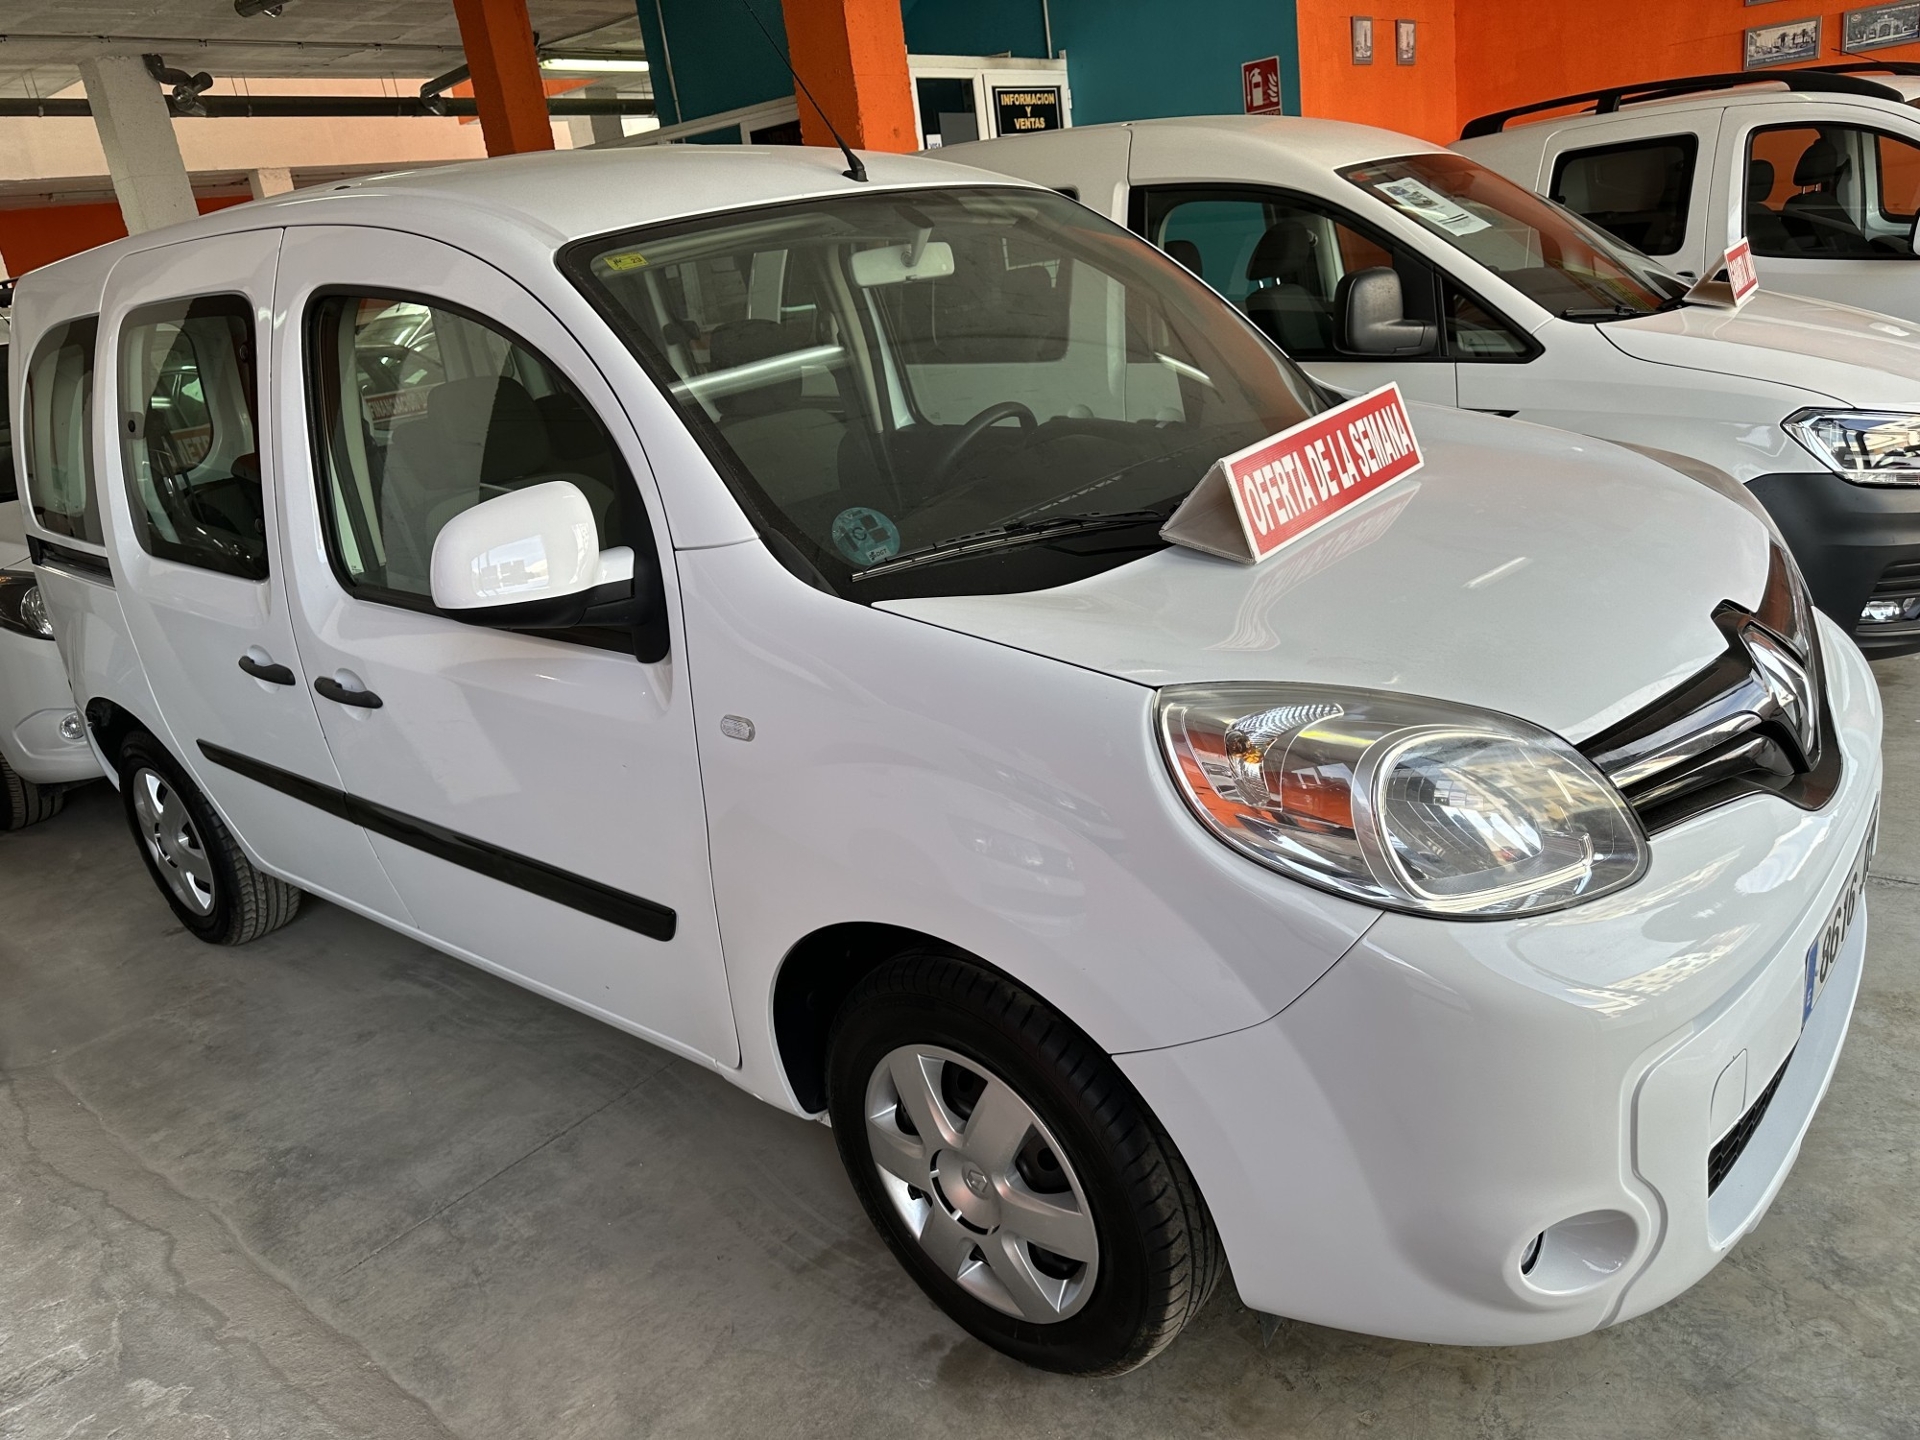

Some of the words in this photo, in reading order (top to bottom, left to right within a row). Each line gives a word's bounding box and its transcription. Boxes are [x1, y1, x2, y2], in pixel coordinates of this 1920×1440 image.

[1000, 93, 1055, 105] INFORMACION
[1025, 105, 1032, 117] Y
[1014, 117, 1045, 129] VENTAS
[1243, 451, 1318, 536] OFERTA
[1304, 438, 1340, 501] DE
[1327, 429, 1361, 490] LA
[1348, 402, 1413, 478] SEMANA
